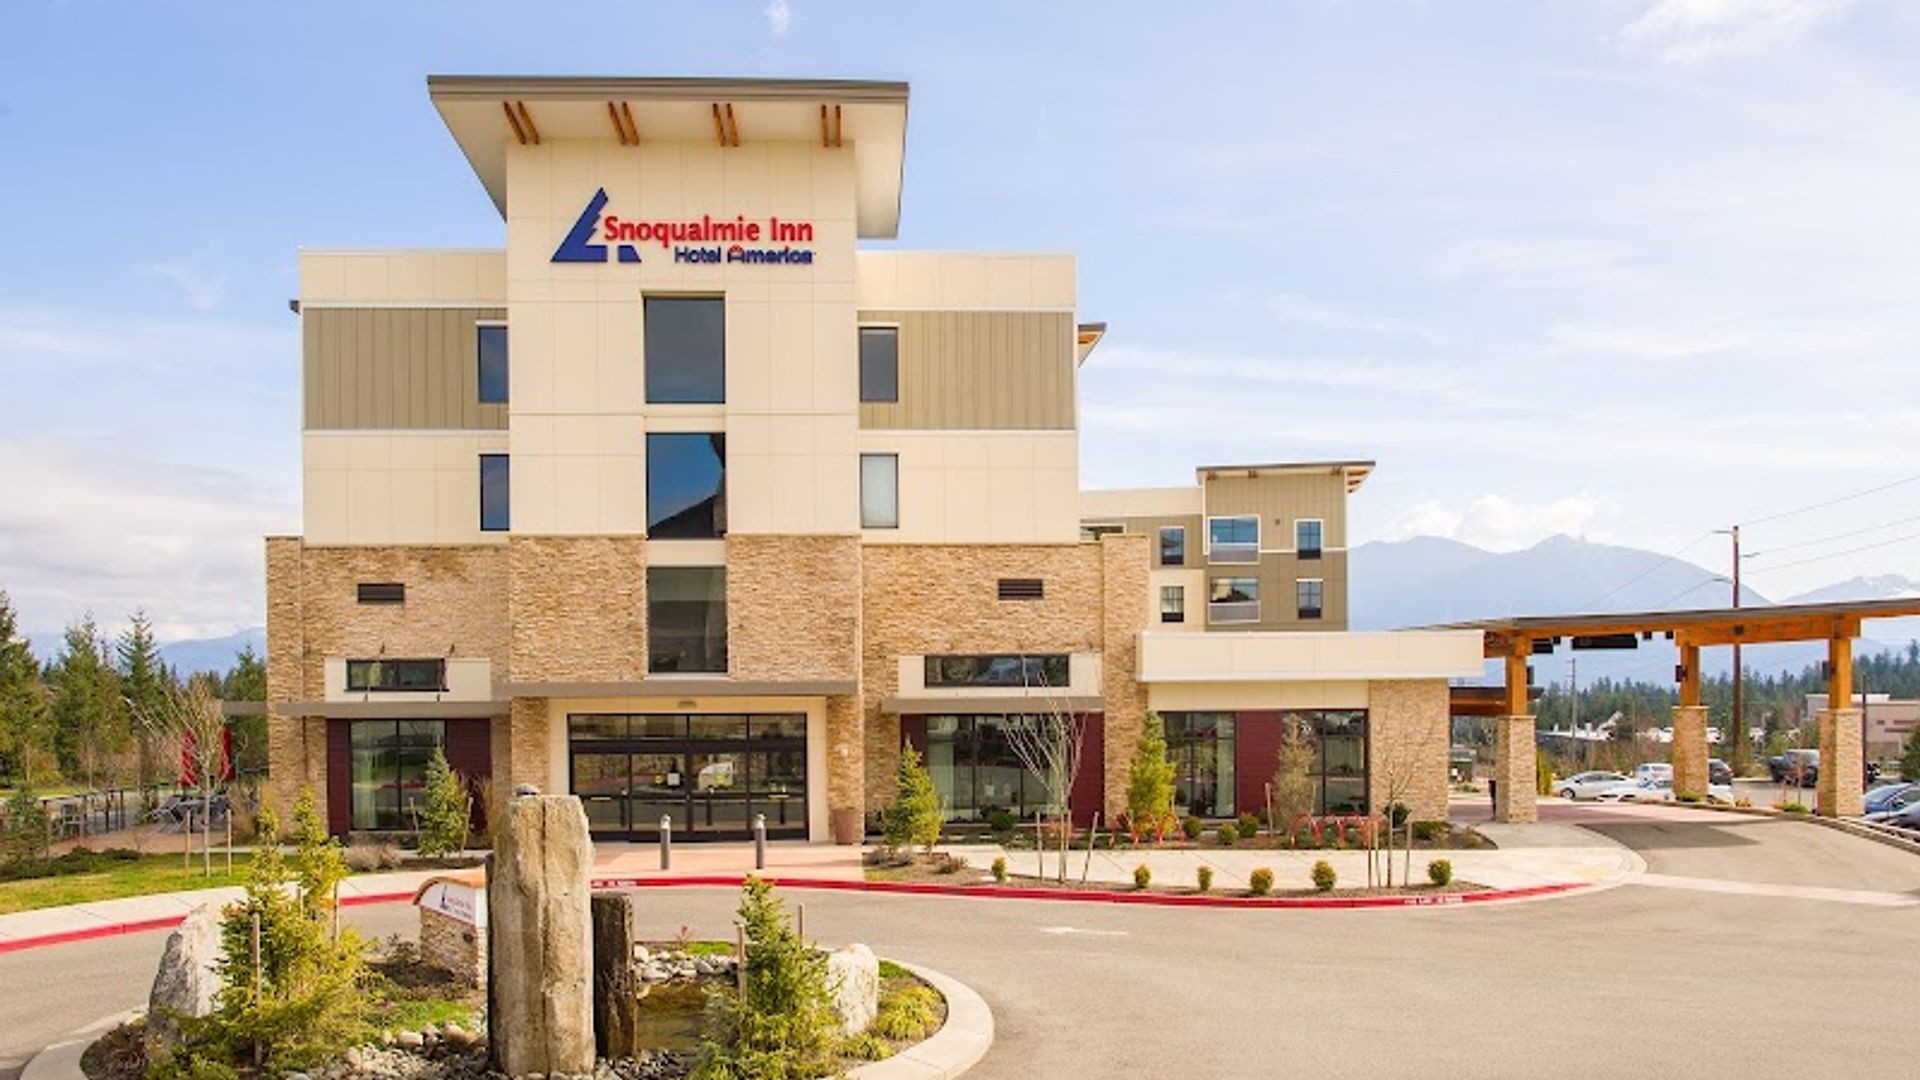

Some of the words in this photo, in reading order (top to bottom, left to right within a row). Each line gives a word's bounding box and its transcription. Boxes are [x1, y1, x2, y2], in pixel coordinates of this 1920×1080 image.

[604, 214, 760, 247] Snoqualmie
[770, 217, 813, 241] Inn
[674, 246, 721, 264] Hotel
[727, 245, 813, 264] America
